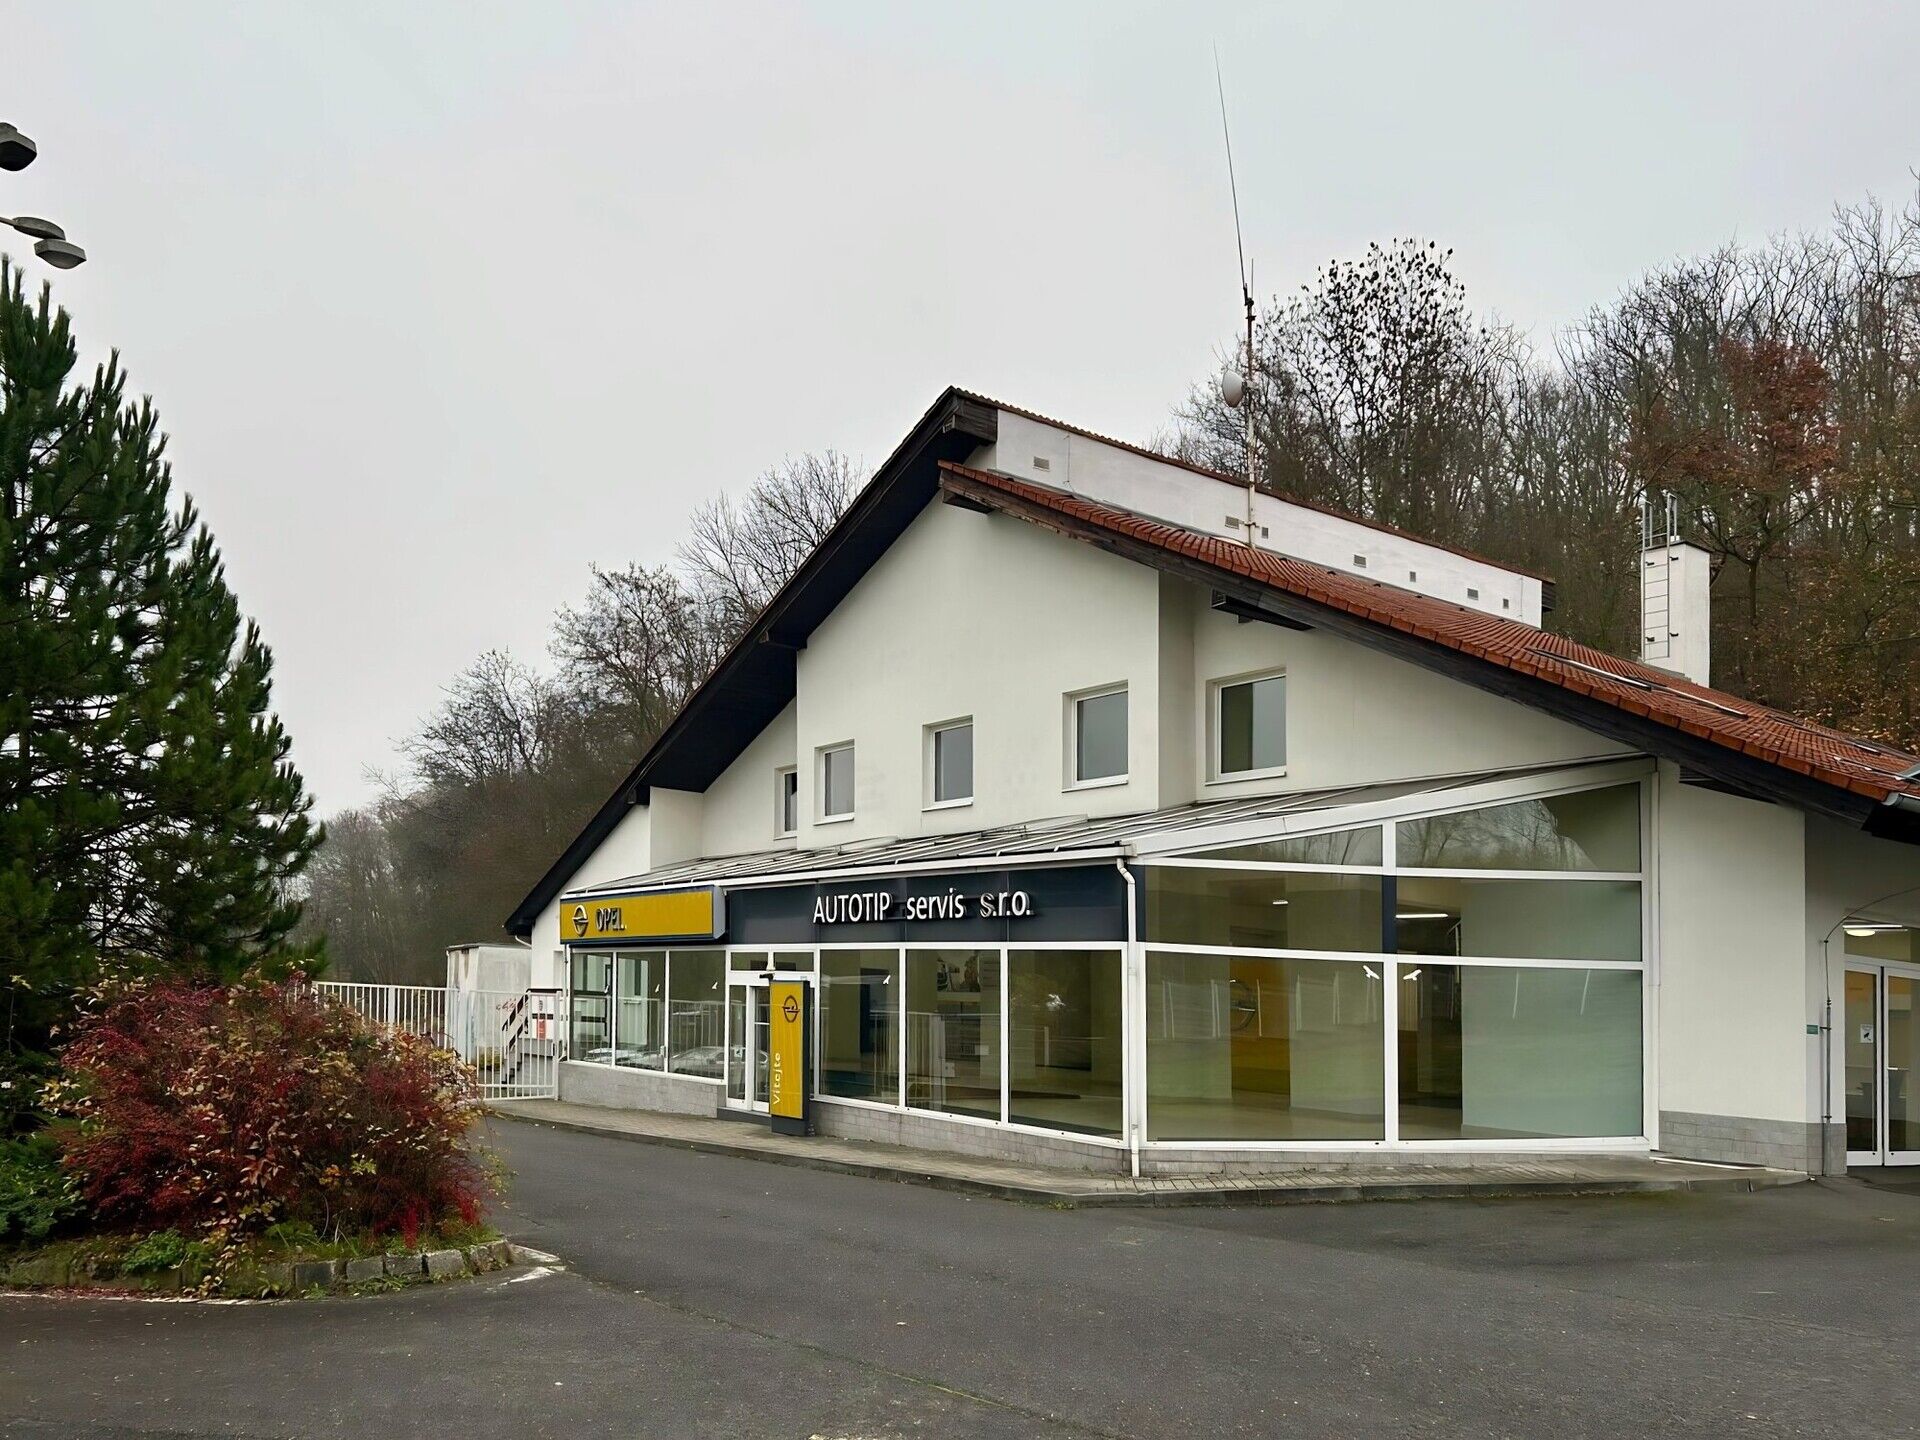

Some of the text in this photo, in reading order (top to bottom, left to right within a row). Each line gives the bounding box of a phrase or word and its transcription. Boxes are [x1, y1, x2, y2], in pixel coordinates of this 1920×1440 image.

[596, 908, 625, 931] OPEL
[813, 888, 1033, 923] AUTOTIP servis s.r.o.
